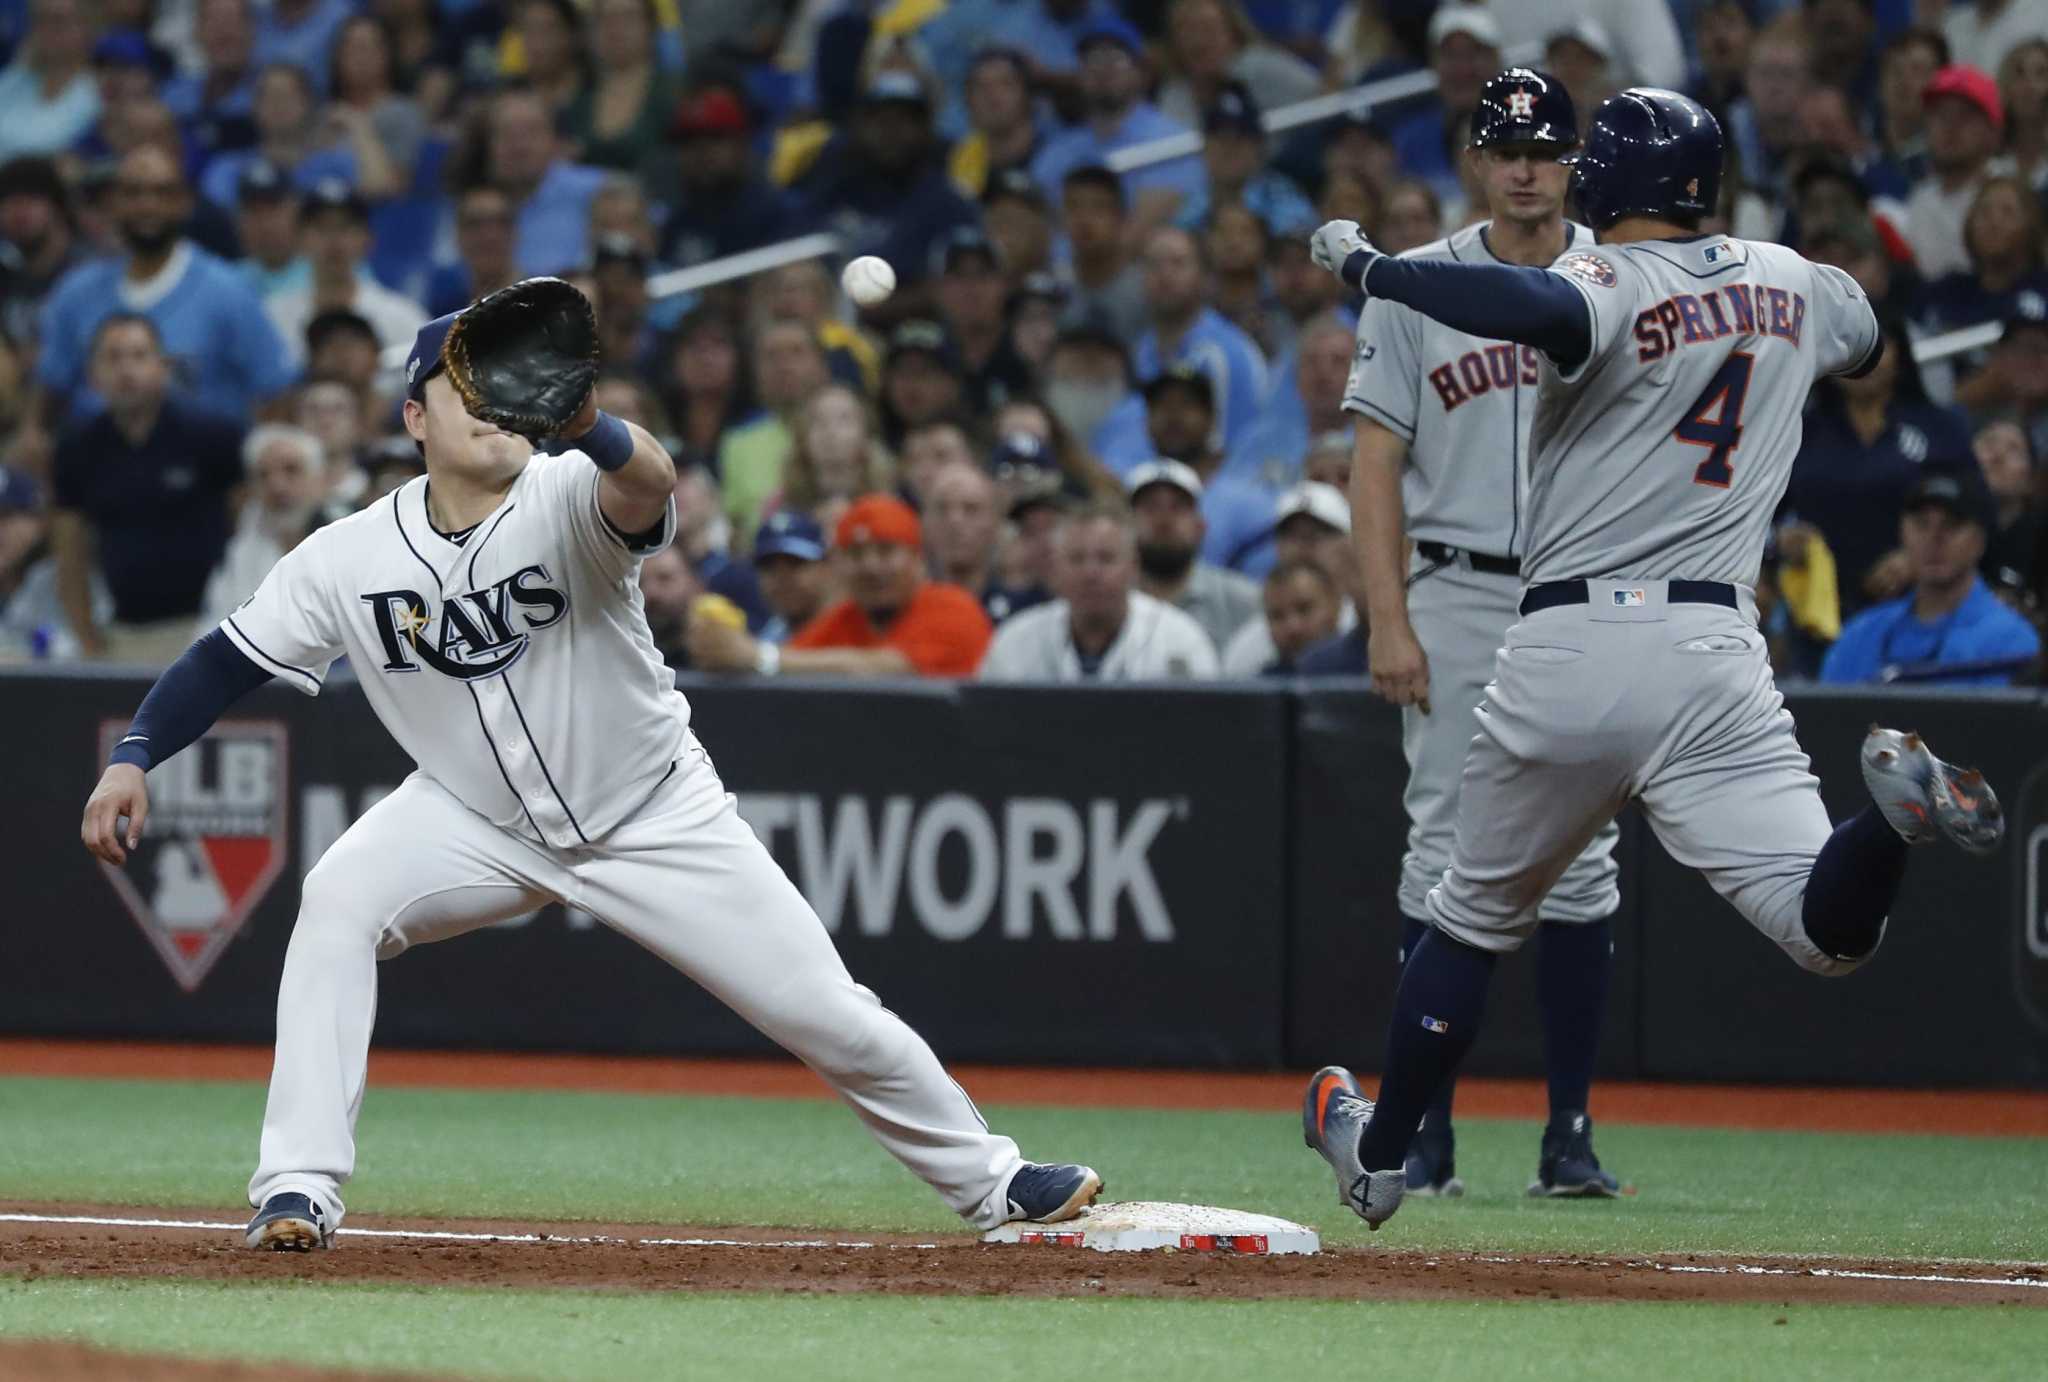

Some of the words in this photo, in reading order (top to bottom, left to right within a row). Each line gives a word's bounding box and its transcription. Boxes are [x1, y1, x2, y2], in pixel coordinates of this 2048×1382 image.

[1510, 92, 1533, 117] H
[1632, 284, 1806, 364] SPRINGER
[1428, 341, 1543, 413] HOUS
[1673, 351, 1755, 489] 4
[360, 563, 569, 682] RAYS
[735, 792, 1175, 942] TWORK
[1350, 1174, 1373, 1213] 4
